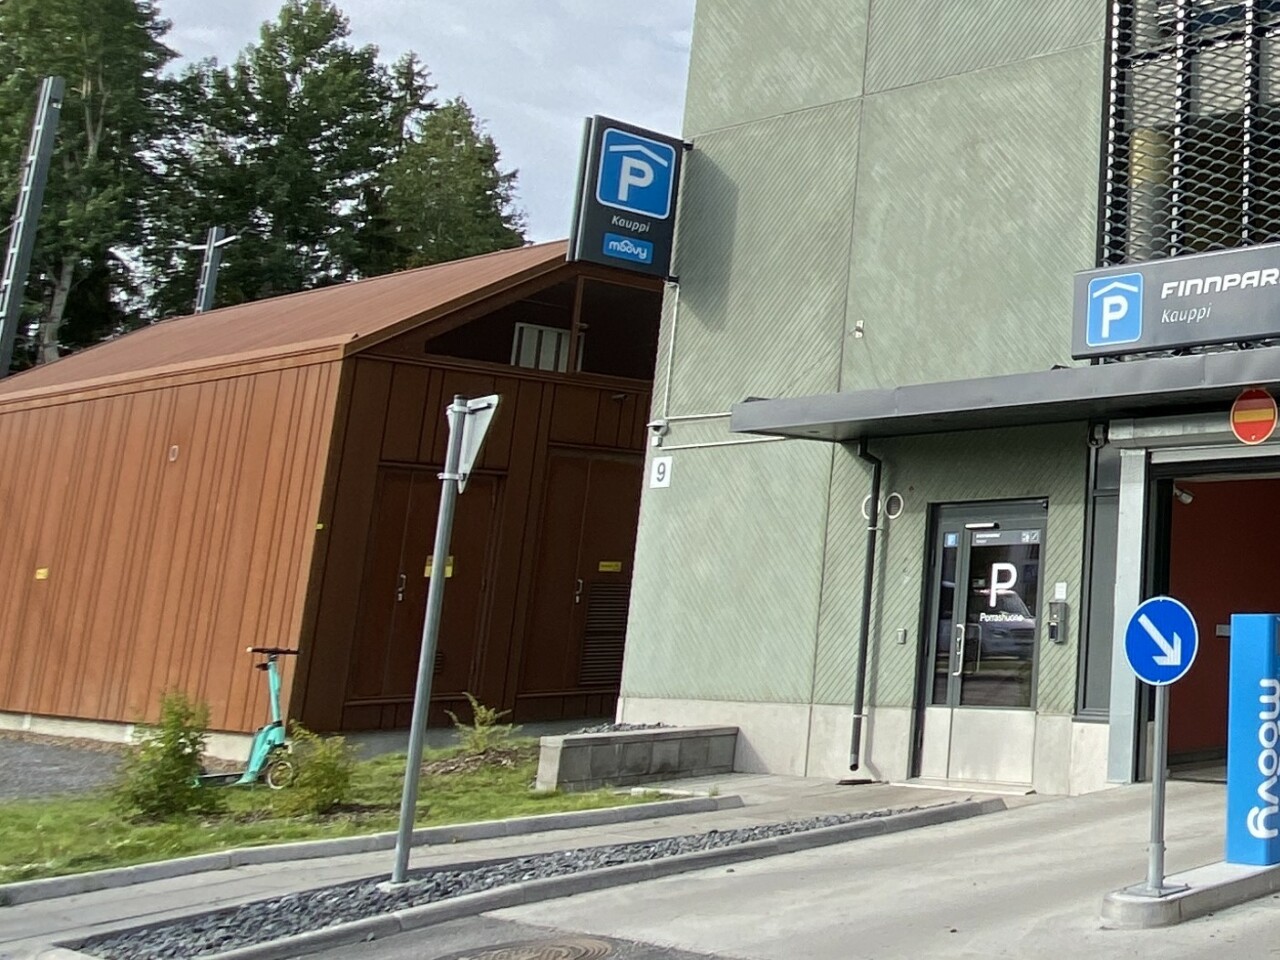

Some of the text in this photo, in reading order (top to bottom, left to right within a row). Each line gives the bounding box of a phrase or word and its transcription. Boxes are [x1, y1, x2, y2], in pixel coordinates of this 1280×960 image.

[618, 155, 654, 202] P
[611, 215, 651, 233] Kauppi
[608, 240, 648, 259] moovy
[1101, 295, 1128, 339] P
[1161, 302, 1213, 324] Kauppi
[656, 462, 666, 483] 9
[989, 562, 1018, 607] P
